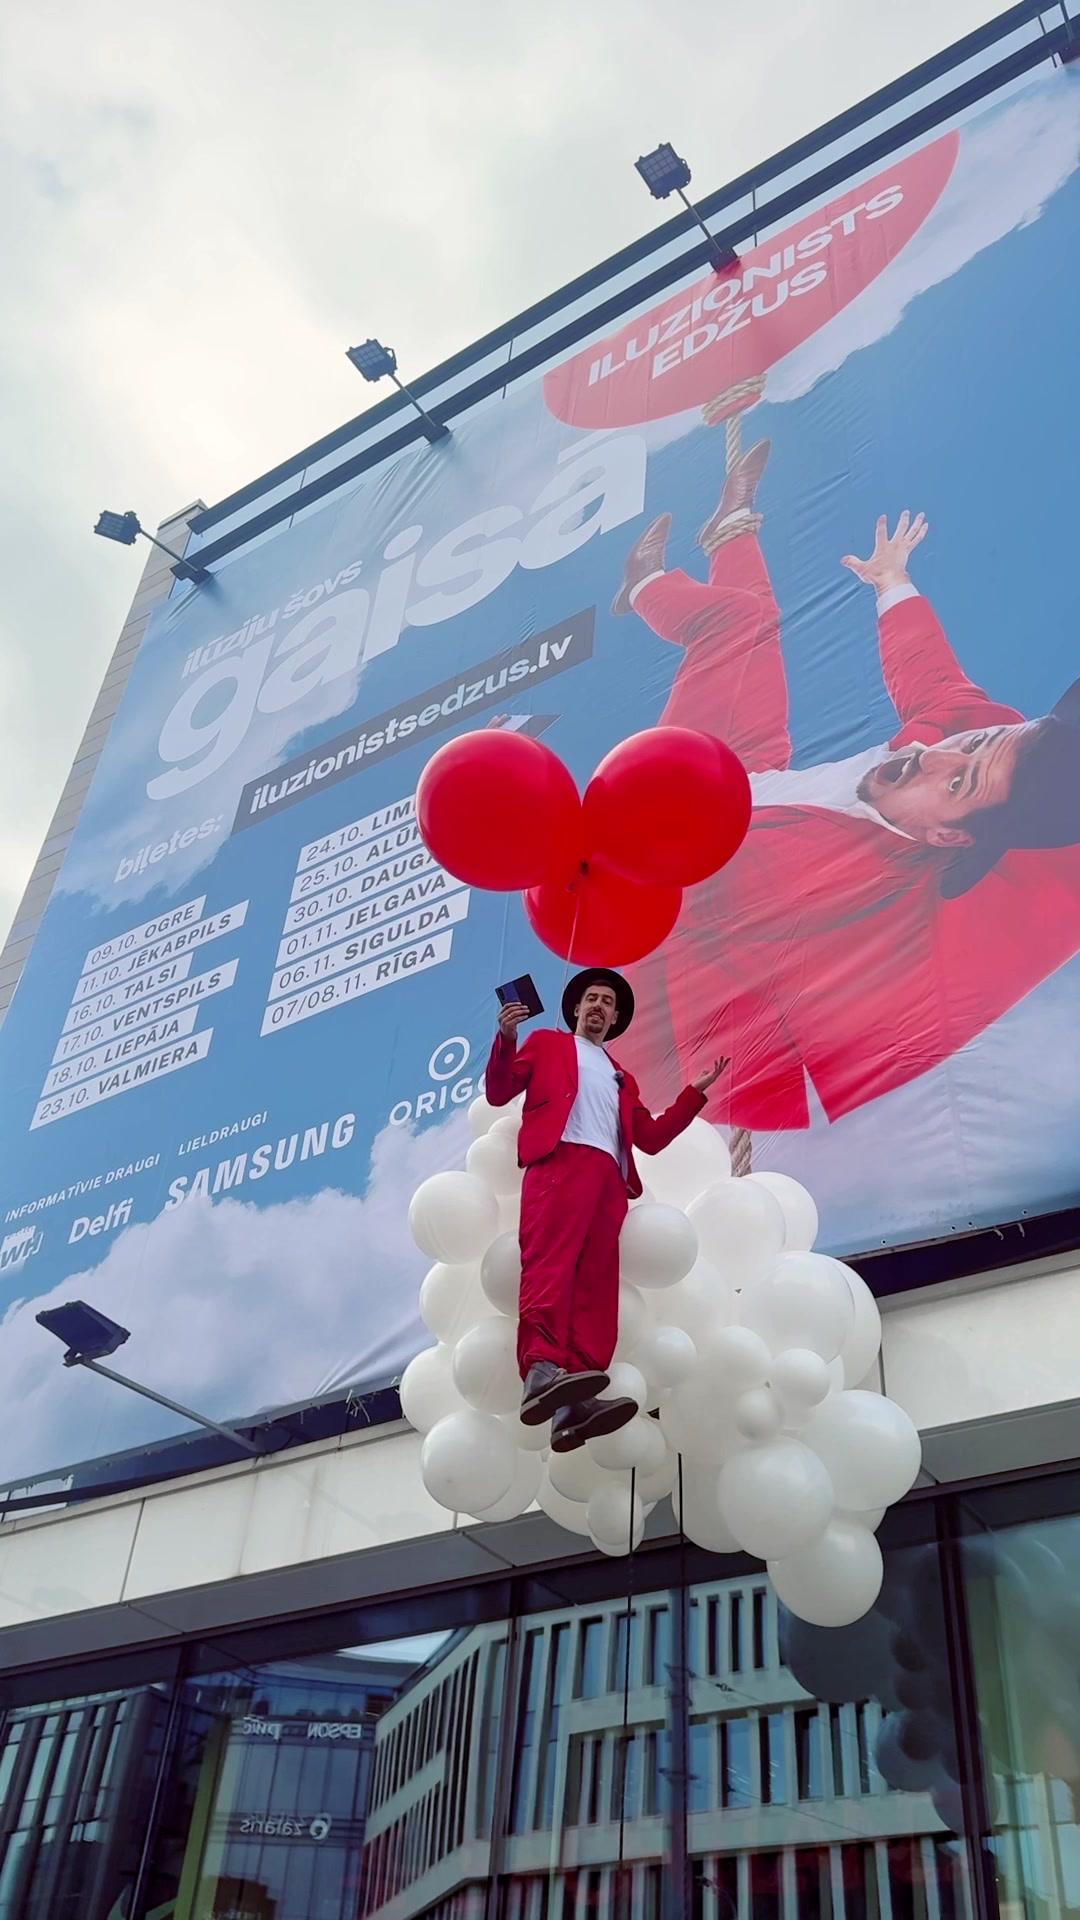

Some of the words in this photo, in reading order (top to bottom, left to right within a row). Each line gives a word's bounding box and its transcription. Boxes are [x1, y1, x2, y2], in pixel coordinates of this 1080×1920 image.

[588, 184, 904, 386] ILUZIONISTS
[652, 261, 827, 379] EDŽUS
[147, 430, 647, 800] gaisā
[181, 608, 280, 679] ilūziju
[281, 560, 363, 619] šovs
[249, 635, 573, 814] iluzionistsedzus.lv
[114, 813, 224, 884] biļetes:
[306, 826, 364, 862] 24.10.
[371, 801, 416, 831] LIM
[287, 922, 337, 955] 01.11.
[345, 874, 446, 930] JELGAVA
[293, 887, 352, 923] 30.10.
[300, 856, 358, 893] 25.10.
[82, 966, 122, 993] 11.10.
[127, 913, 232, 972] JĒKABPILS
[91, 934, 137, 964] 09.10.
[144, 904, 196, 939] OGRE
[279, 955, 335, 989] 06.11.
[345, 904, 450, 961] SIGULDA
[63, 1026, 104, 1054] 17.10.
[113, 972, 221, 1032] VENTSPILS
[73, 995, 116, 1023] 16.10.
[124, 964, 177, 999] TALSI
[271, 973, 366, 1024] 07/08.11.
[376, 943, 436, 981] RĪGA
[39, 1088, 89, 1120] 23.10.
[98, 1040, 198, 1095] VALMIERA
[52, 1056, 97, 1086] 18.10.
[104, 1019, 179, 1063] LIEPĀJA
[164, 1113, 356, 1212] SAMSUNG
[178, 1111, 268, 1156] LIELDRAUGI
[5, 1175, 102, 1223] INFORMATĪVIE
[105, 1153, 160, 1184] DRAUGI
[68, 1198, 134, 1244] Delfi
